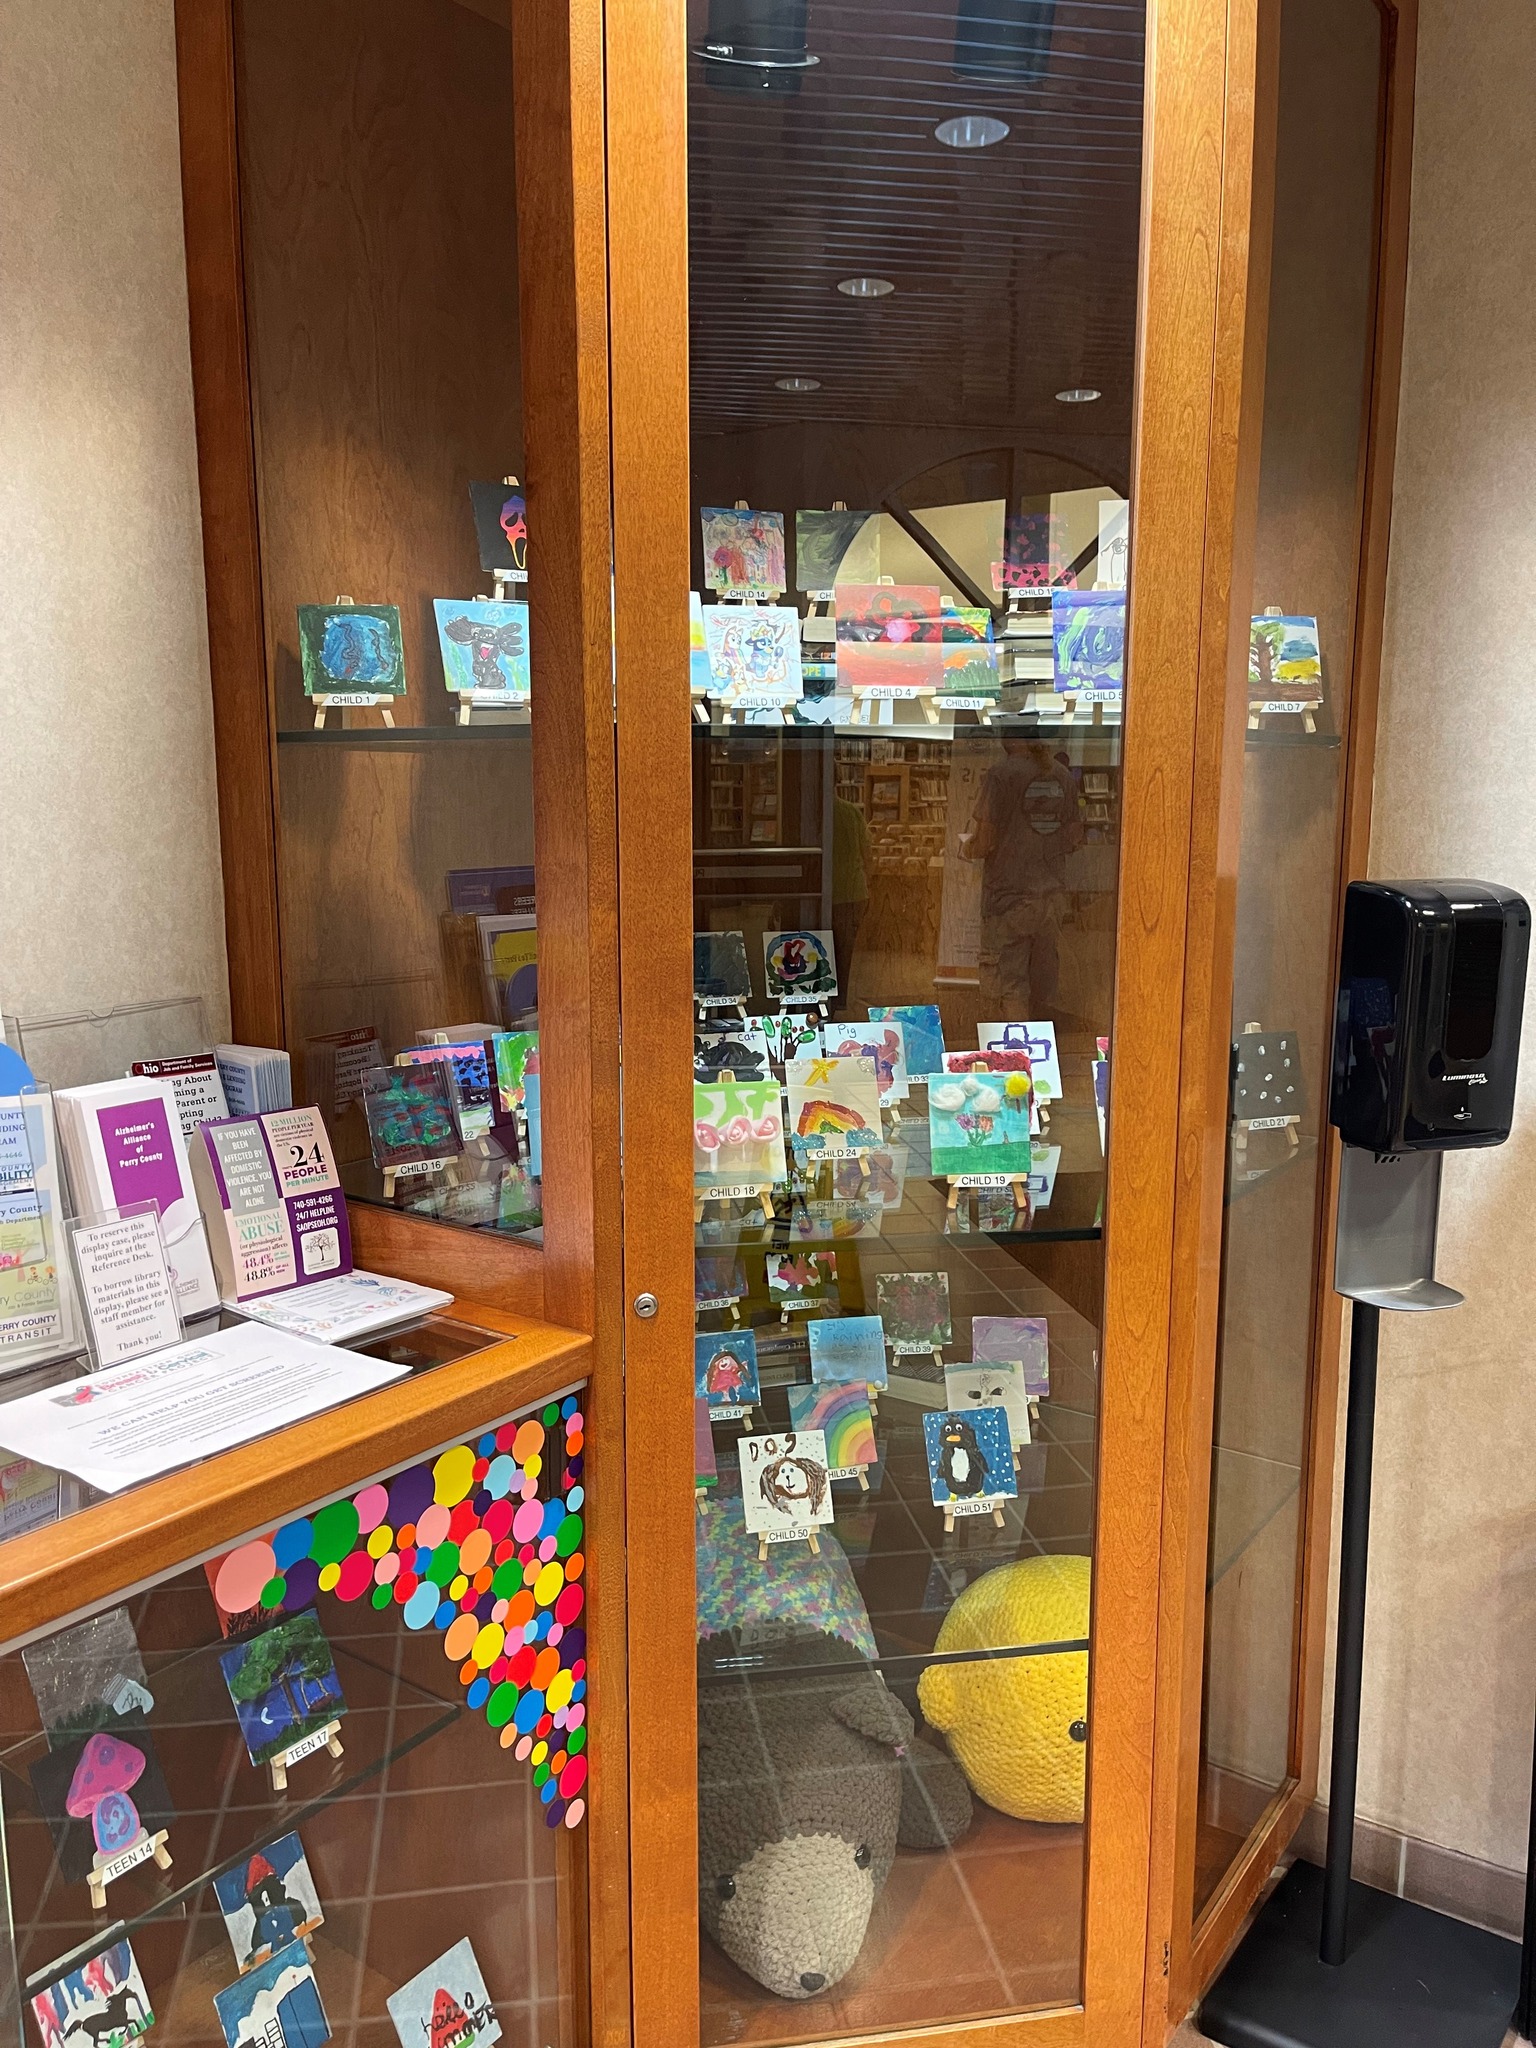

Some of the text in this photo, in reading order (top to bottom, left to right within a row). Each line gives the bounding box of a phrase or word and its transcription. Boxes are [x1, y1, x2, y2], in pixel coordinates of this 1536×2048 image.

[730, 590, 754, 598] CHILD
[1018, 588, 1041, 596] CHILD
[512, 691, 519, 700] 2
[871, 688, 912, 697] CHILD 4
[1085, 691, 1116, 700] CHILD
[332, 696, 363, 705] CHILD
[739, 698, 781, 706] CHILD 10
[946, 699, 981, 708] CHILD 11
[1268, 703, 1294, 711] CHILD
[706, 998, 728, 1006] CHILD
[837, 1023, 857, 1039] Pig
[184, 1074, 212, 1085] About
[174, 1087, 197, 1097] ming
[176, 1095, 217, 1108] Parent or
[0, 1112, 26, 1120] UNTY
[180, 1109, 204, 1120] pting
[115, 1122, 155, 1136] Alzheimer's
[1253, 1118, 1286, 1128] CHILD 21
[123, 1134, 151, 1145] Alliance
[224, 1130, 239, 1140] YOU
[238, 1127, 256, 1137] HAVE
[464, 1131, 474, 1139] 22
[135, 1144, 144, 1153] of
[231, 1140, 249, 1150] BEEN
[119, 1152, 163, 1168] Perry County
[224, 1149, 263, 1163] AFFECTED BY
[290, 1142, 325, 1168] 24
[816, 1149, 857, 1159] CHILD 24
[230, 1161, 262, 1174] DOMESTIC
[284, 1164, 328, 1180] PEOPLE
[400, 1160, 441, 1175] CHILD 16
[0, 1169, 33, 1181] ILITY
[226, 1171, 272, 1187] VIOLENCE, YOU
[286, 1174, 329, 1187] PER MINUTE
[962, 1176, 1006, 1185] CHILD 19
[239, 1184, 265, 1196] ARE NOT
[710, 1186, 755, 1198] CHILD 18
[245, 1196, 265, 1208] ALONE
[10, 1205, 43, 1214] County
[295, 1205, 335, 1221] 24/7 HELPLINE
[6, 1216, 42, 1224] Departmen
[235, 1211, 281, 1228] EMOTIONAL
[100, 1227, 129, 1239] reserve
[130, 1222, 145, 1231] this
[239, 1220, 285, 1242] ABUSE
[81, 1230, 156, 1254] display case, please
[94, 1242, 147, 1262] inquire at the
[91, 1250, 154, 1273] Reference Desk.
[91, 1269, 162, 1294] To borrow library
[98, 1281, 161, 1304] materials in this
[93, 1302, 125, 1316] display,
[125, 1294, 150, 1309] please
[150, 1290, 163, 1299] see
[698, 1301, 720, 1310] CHILD
[788, 1301, 810, 1309] CHILD
[100, 1299, 166, 1324] staff member for
[0, 1314, 57, 1331] RRY COUNTY
[115, 1315, 157, 1331] assistance.
[0, 1327, 51, 1344] TRANSIT
[117, 1330, 162, 1351] Thank you!
[899, 1346, 921, 1354] CHILD
[98, 1364, 285, 1436] WE CAN HELP YOU GET SCREENED
[709, 1409, 741, 1420] CHILD 41
[828, 1467, 858, 1479] HILD 45
[954, 1503, 992, 1515] CHILD 51
[769, 1528, 808, 1541] CHILD 50
[288, 1731, 328, 1761] TEEN 17
[106, 1842, 153, 1878] TEEN 14
